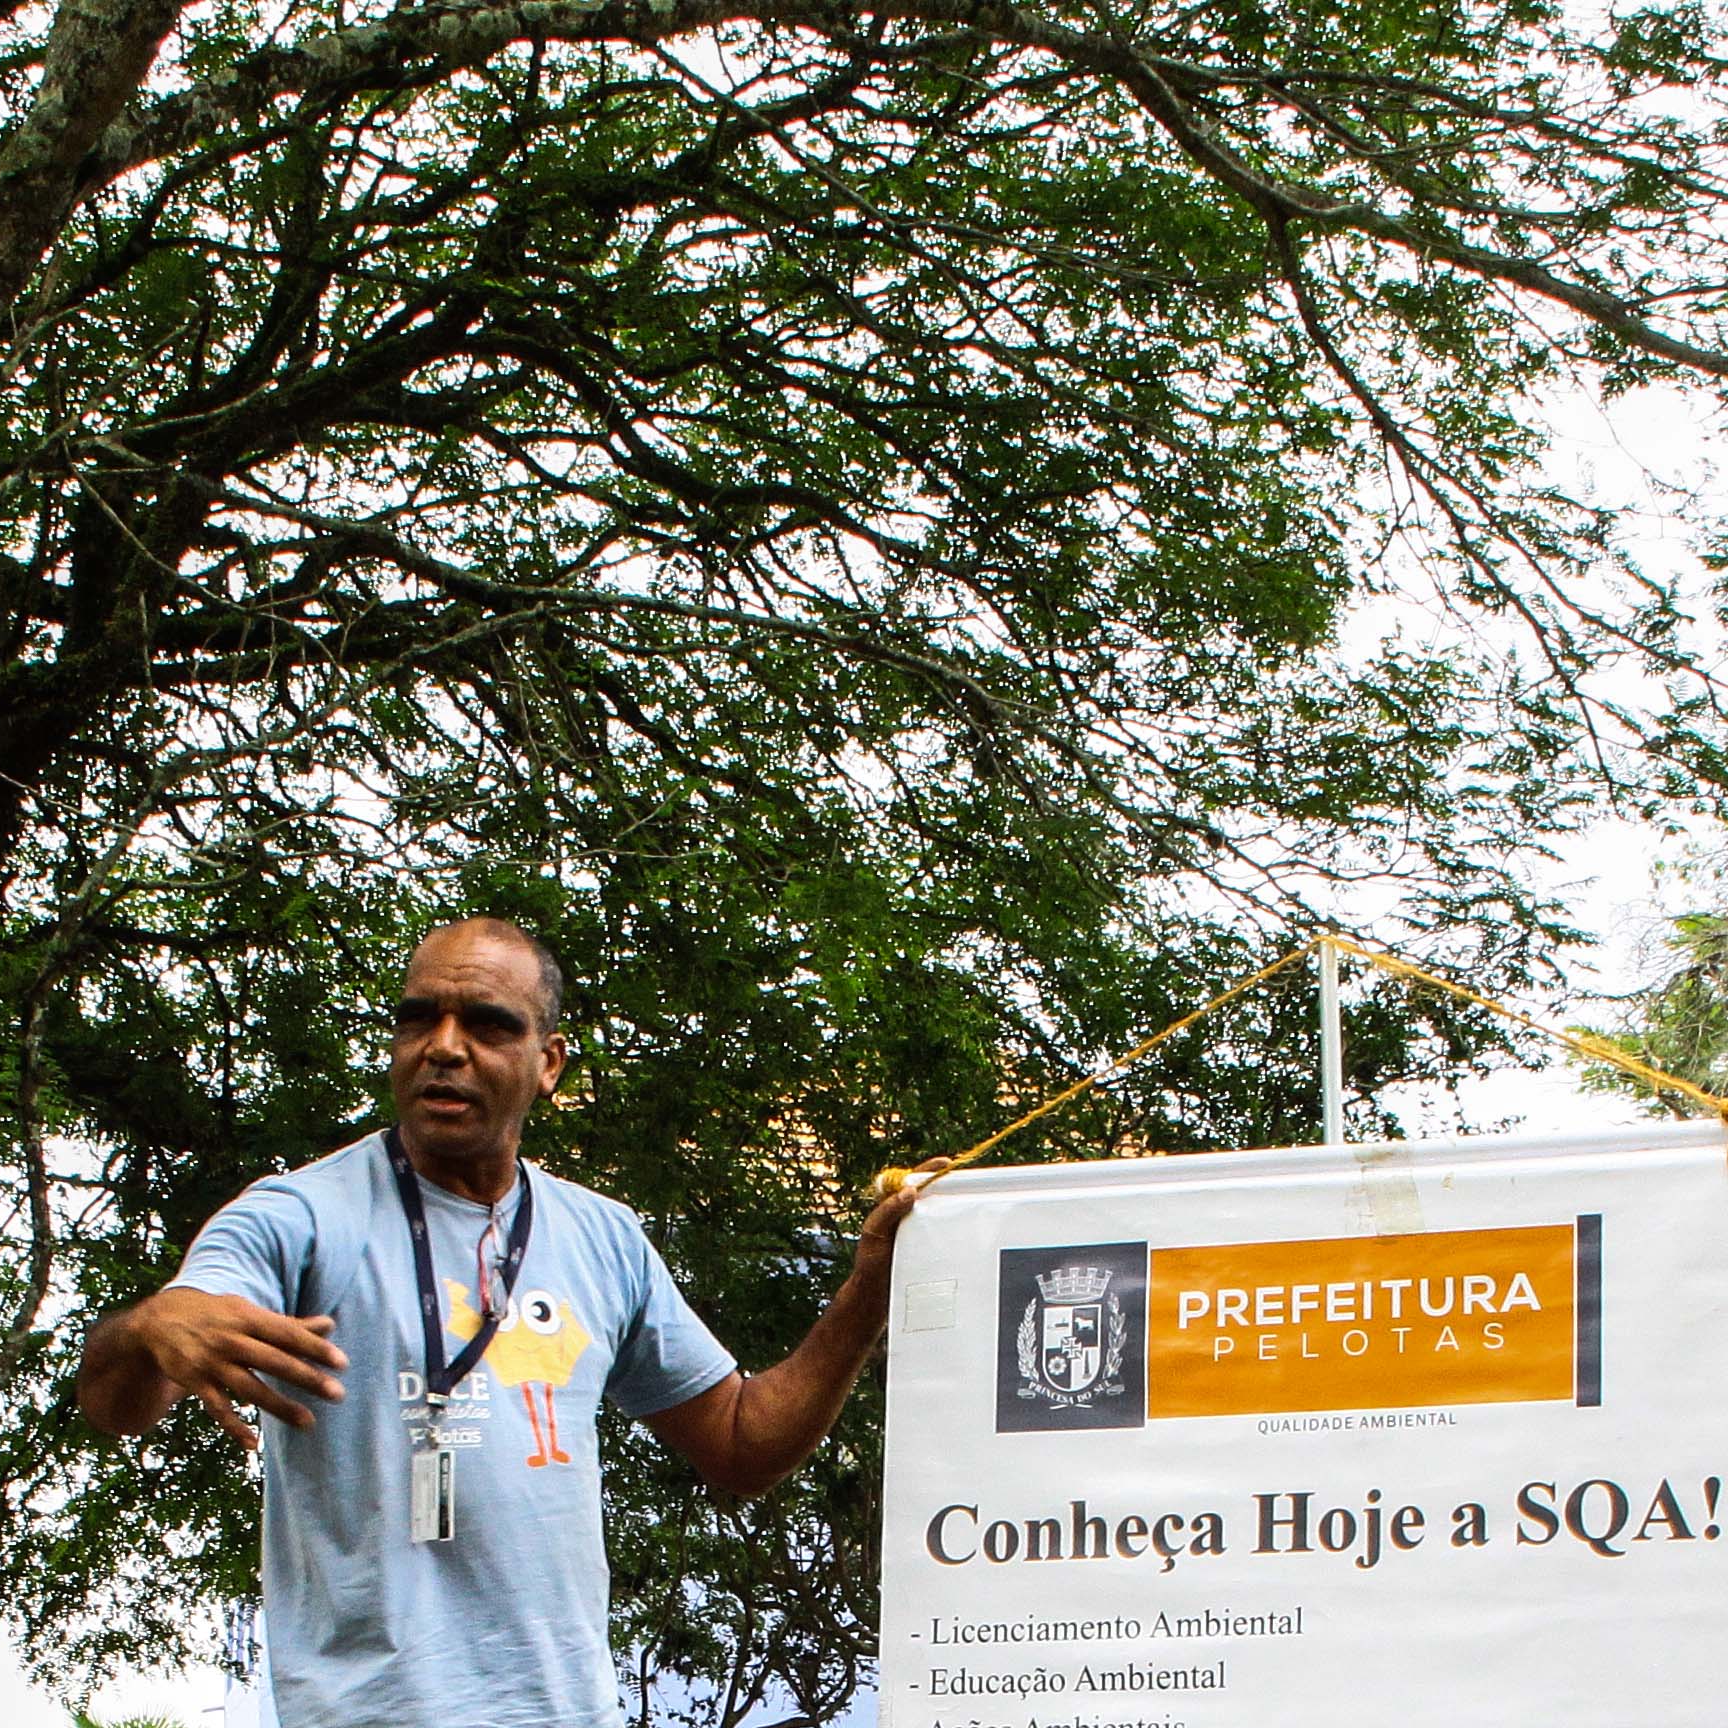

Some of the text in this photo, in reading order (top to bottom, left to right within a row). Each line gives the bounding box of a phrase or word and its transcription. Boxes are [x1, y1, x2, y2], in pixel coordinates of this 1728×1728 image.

[1178, 1272, 1542, 1330] PREFEITURA
[1213, 1322, 1505, 1362] PELOTAS
[398, 1372, 491, 1401] DCE
[1257, 1412, 1458, 1436] QUALIDADE AMBIENTAL
[926, 1476, 1721, 1574] Conheça Hoje a SQA!
[931, 1614, 1141, 1645] Licenciamento
[1153, 1606, 1303, 1638] Ambiental
[930, 1667, 1066, 1700] Educação
[1074, 1660, 1225, 1692] Ambiental
